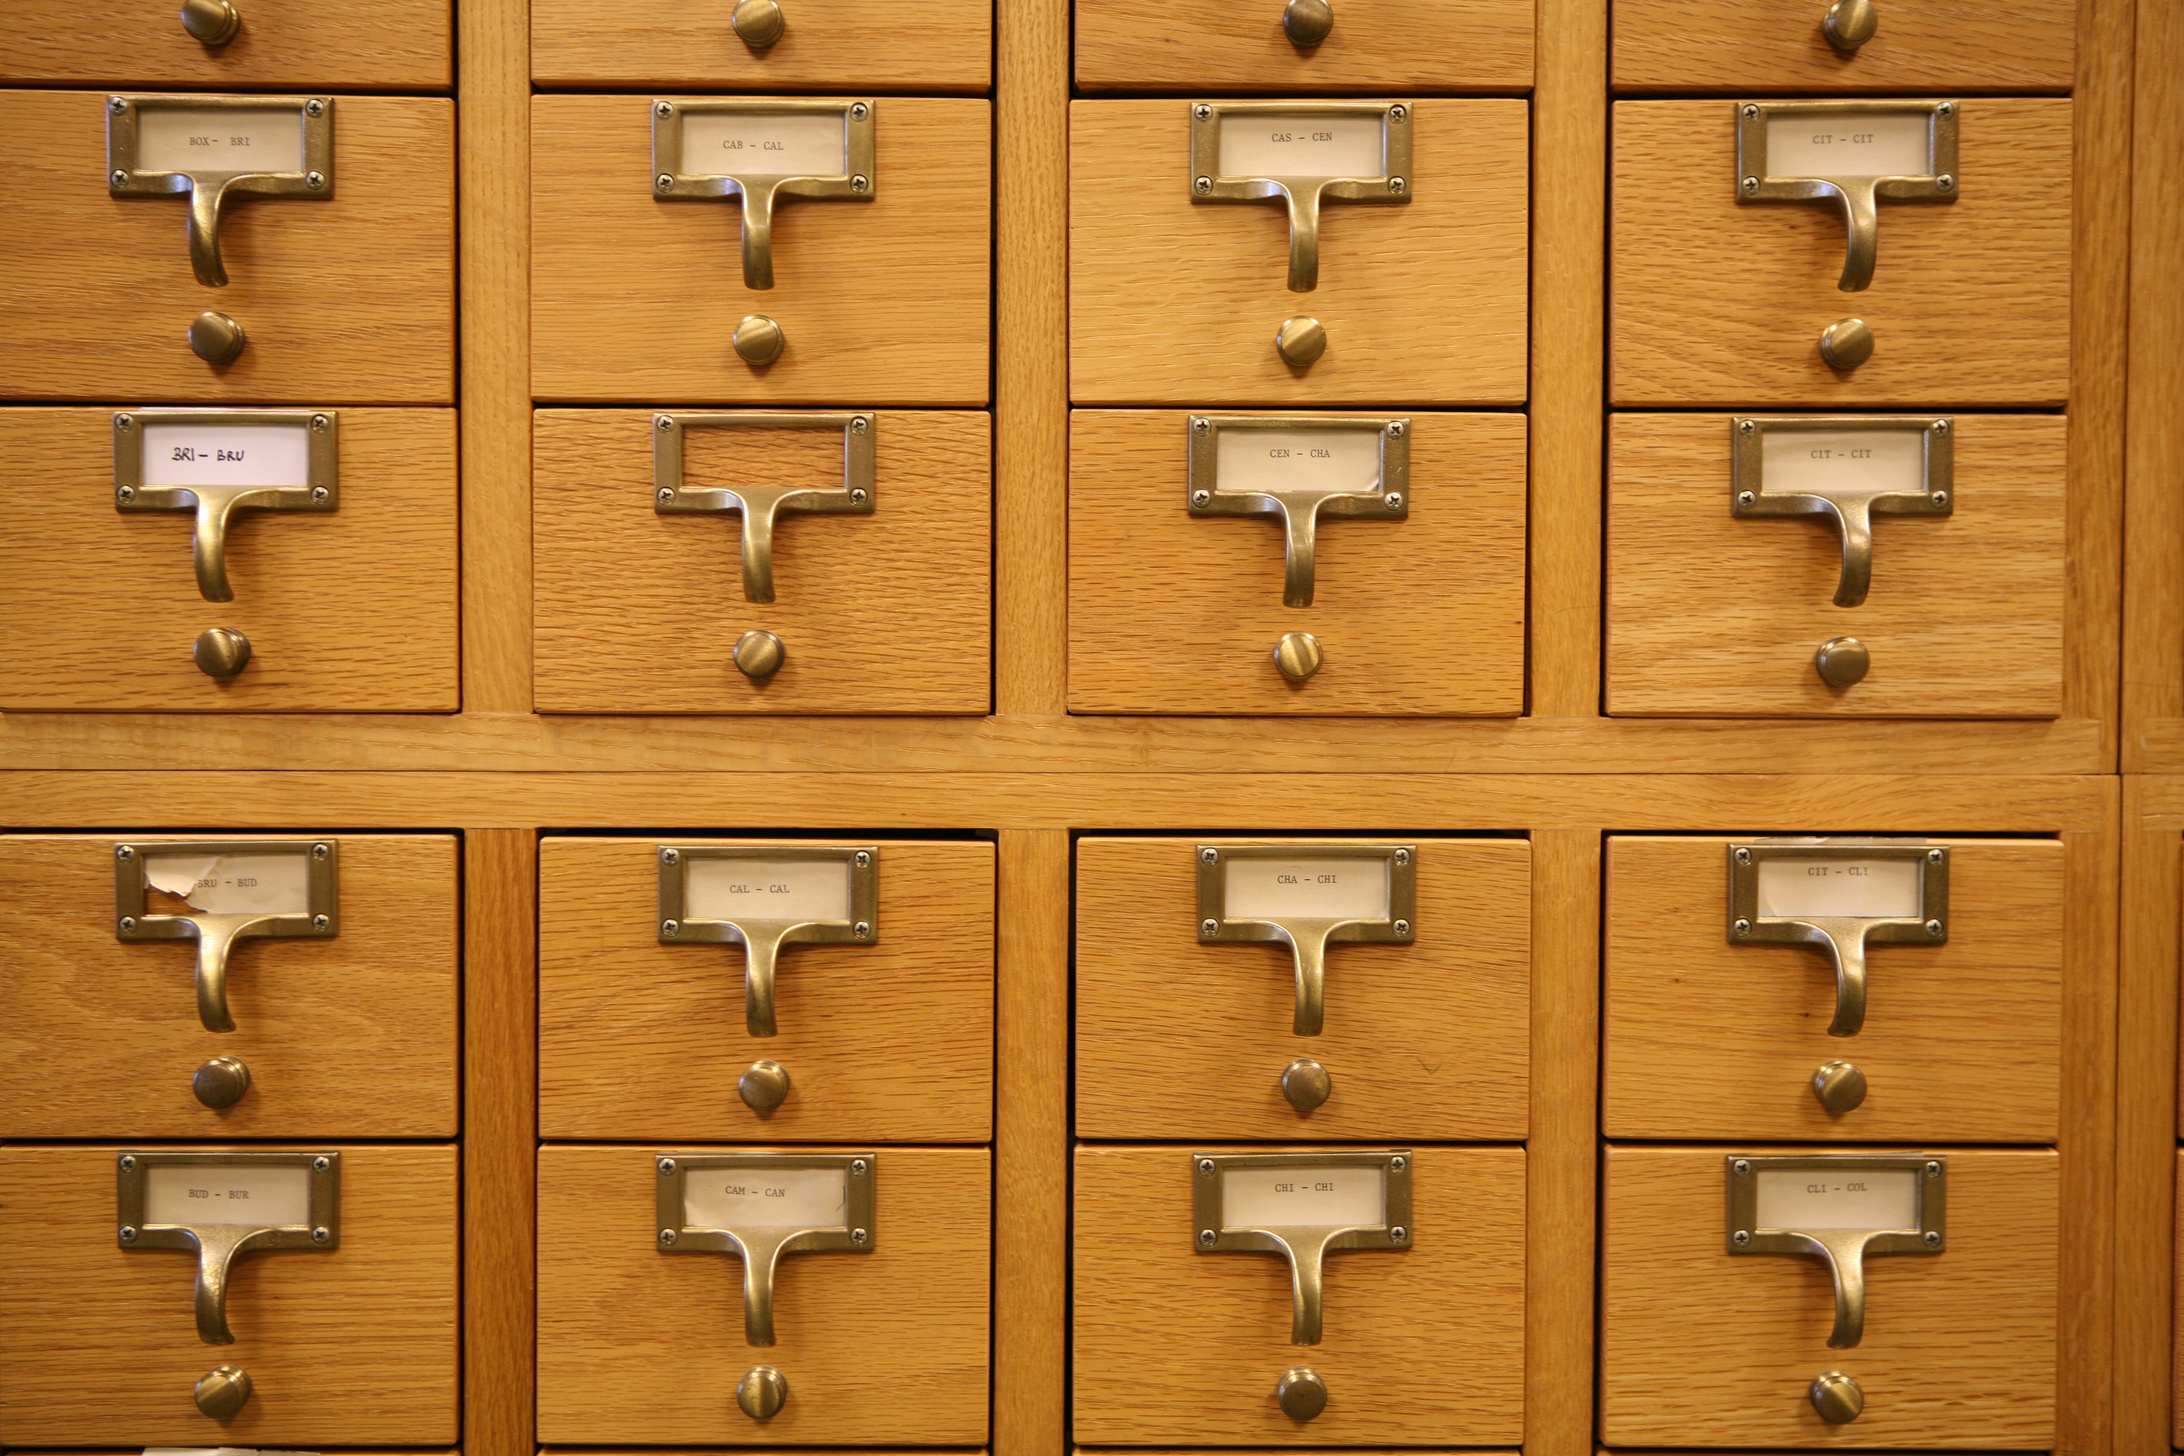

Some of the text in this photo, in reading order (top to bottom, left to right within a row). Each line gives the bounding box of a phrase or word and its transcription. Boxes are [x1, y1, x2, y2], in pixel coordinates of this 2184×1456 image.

[231, 137, 251, 147] BRI
[1272, 133, 1292, 143] CAS
[1312, 132, 1333, 142] CEN
[1813, 135, 1834, 145] CIT
[1853, 134, 1875, 144] CIT
[723, 140, 744, 150] CAB
[764, 141, 784, 151] CAL
[218, 450, 245, 462] BRU
[1270, 449, 1290, 459] CEN
[1310, 449, 1331, 458] CHA
[1811, 450, 1832, 459] CIT
[1851, 449, 1873, 459] CIT
[1808, 867, 1829, 877] CIT
[1848, 867, 1869, 876] CLI
[237, 879, 258, 888] BUD
[1278, 875, 1298, 884] CHA
[1318, 875, 1337, 884] CHI
[730, 885, 750, 894] CAL
[770, 885, 790, 894] CAL
[725, 1186, 746, 1196] CAM
[765, 1188, 786, 1198] CAN
[1275, 1184, 1294, 1193] CHI
[1315, 1183, 1335, 1192] CHI
[1807, 1184, 1827, 1194] CLI
[1847, 1182, 1869, 1192] COL
[189, 1189, 209, 1199] BUD
[229, 1190, 249, 1200] BUR
